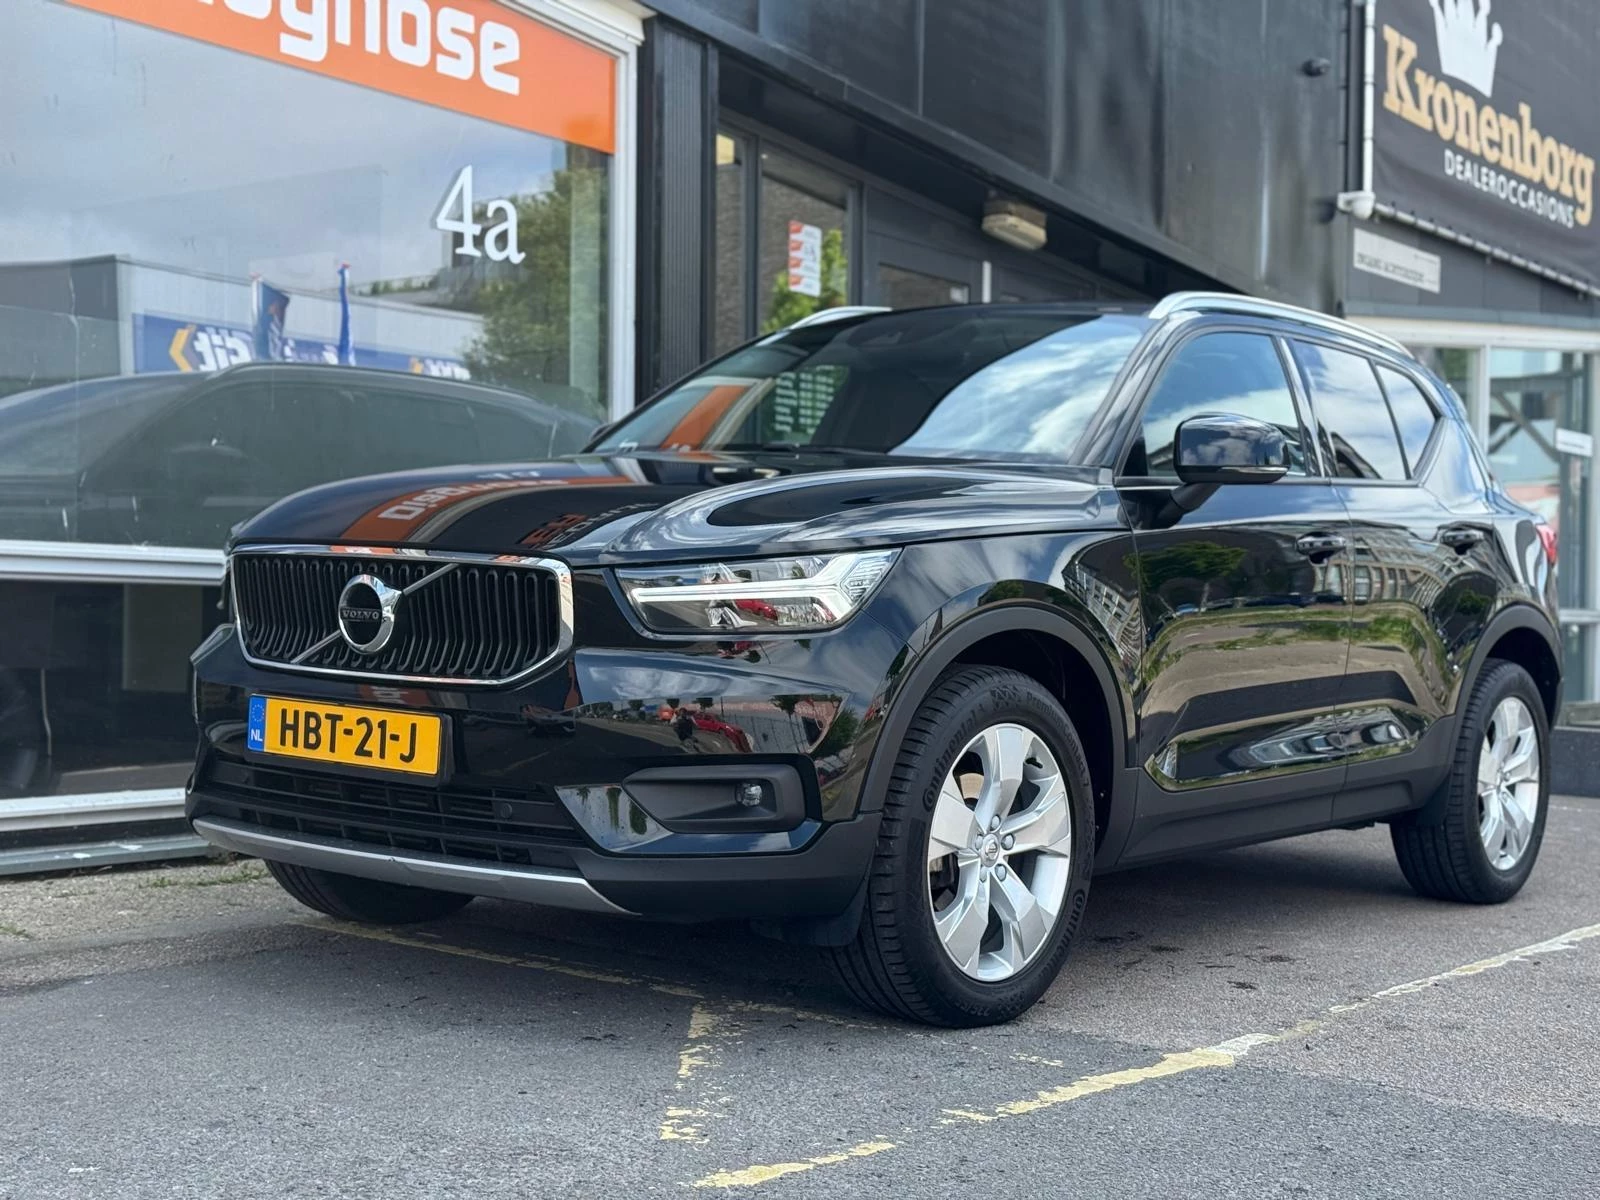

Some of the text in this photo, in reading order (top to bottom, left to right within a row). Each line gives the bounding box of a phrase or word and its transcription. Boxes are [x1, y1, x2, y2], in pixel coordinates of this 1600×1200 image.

[197, 0, 520, 96] gnose
[1383, 24, 1595, 226] Kronenborg
[436, 165, 526, 264] 4a
[1444, 149, 1575, 228] DEALEROCCASIONS
[342, 609, 380, 620] VOLVO
[251, 728, 263, 742] NL
[280, 708, 417, 763] HBT-21-J
[922, 708, 978, 812] Continental
